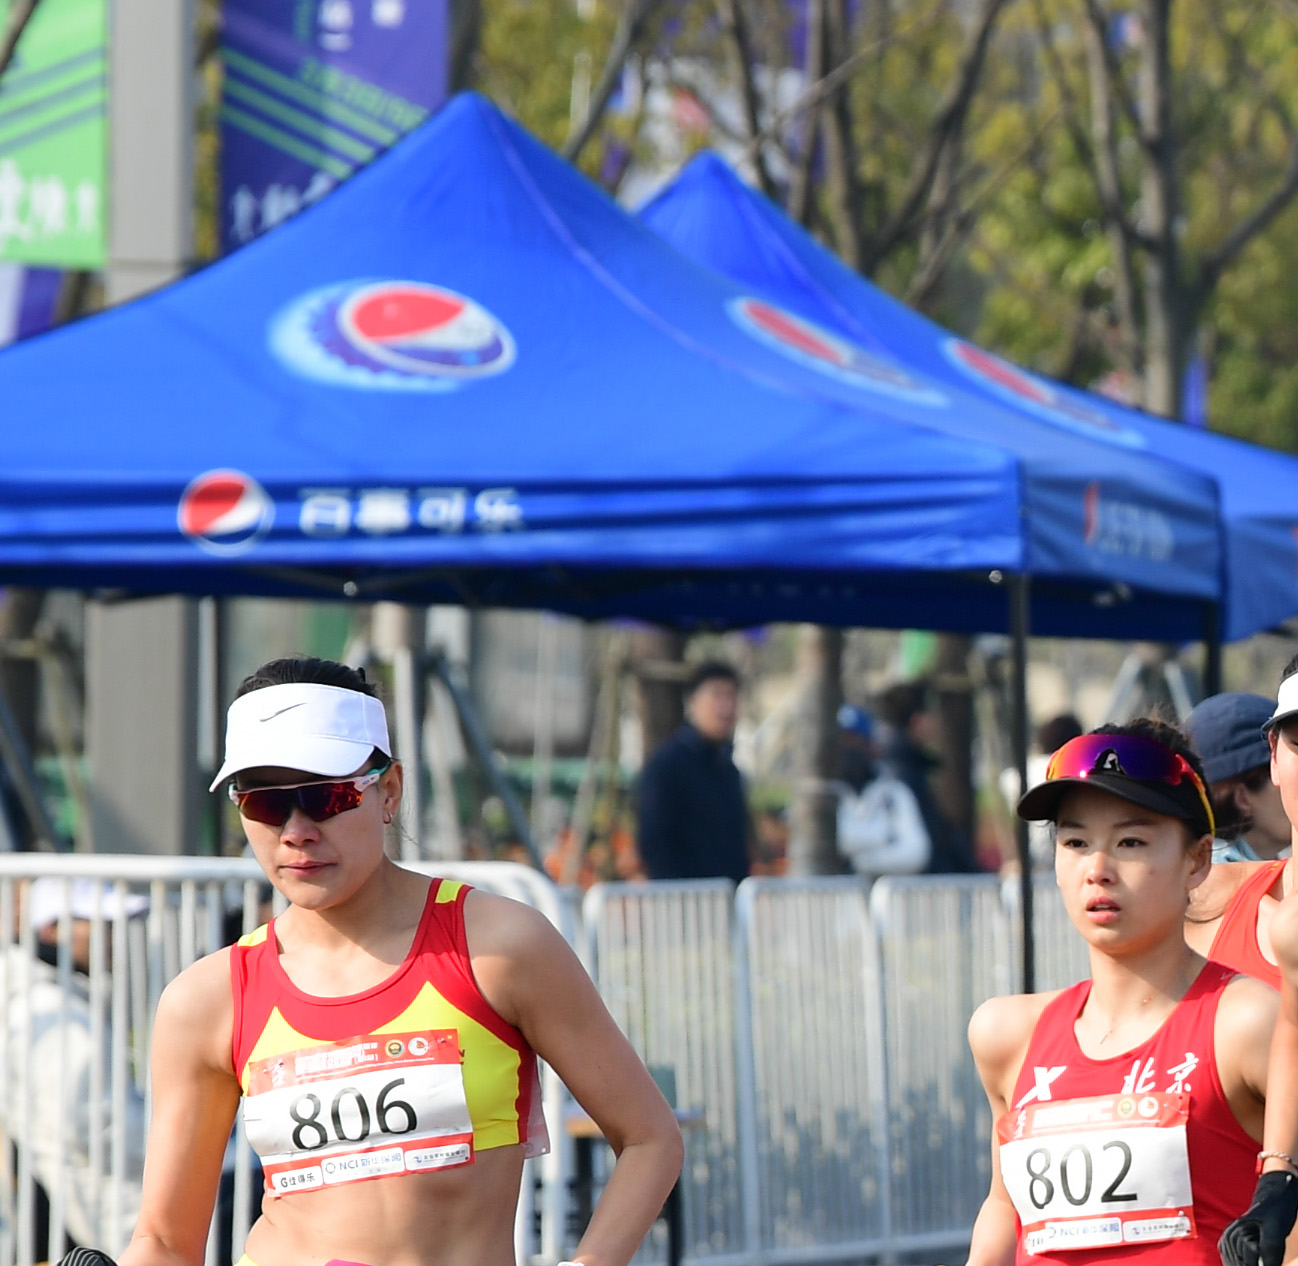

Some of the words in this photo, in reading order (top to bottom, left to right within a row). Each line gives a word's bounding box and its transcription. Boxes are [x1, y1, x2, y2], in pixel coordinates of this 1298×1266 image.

[1121, 1052, 1199, 1094] 北京
[289, 1078, 418, 1151] 806
[1026, 1140, 1138, 1210] 802
